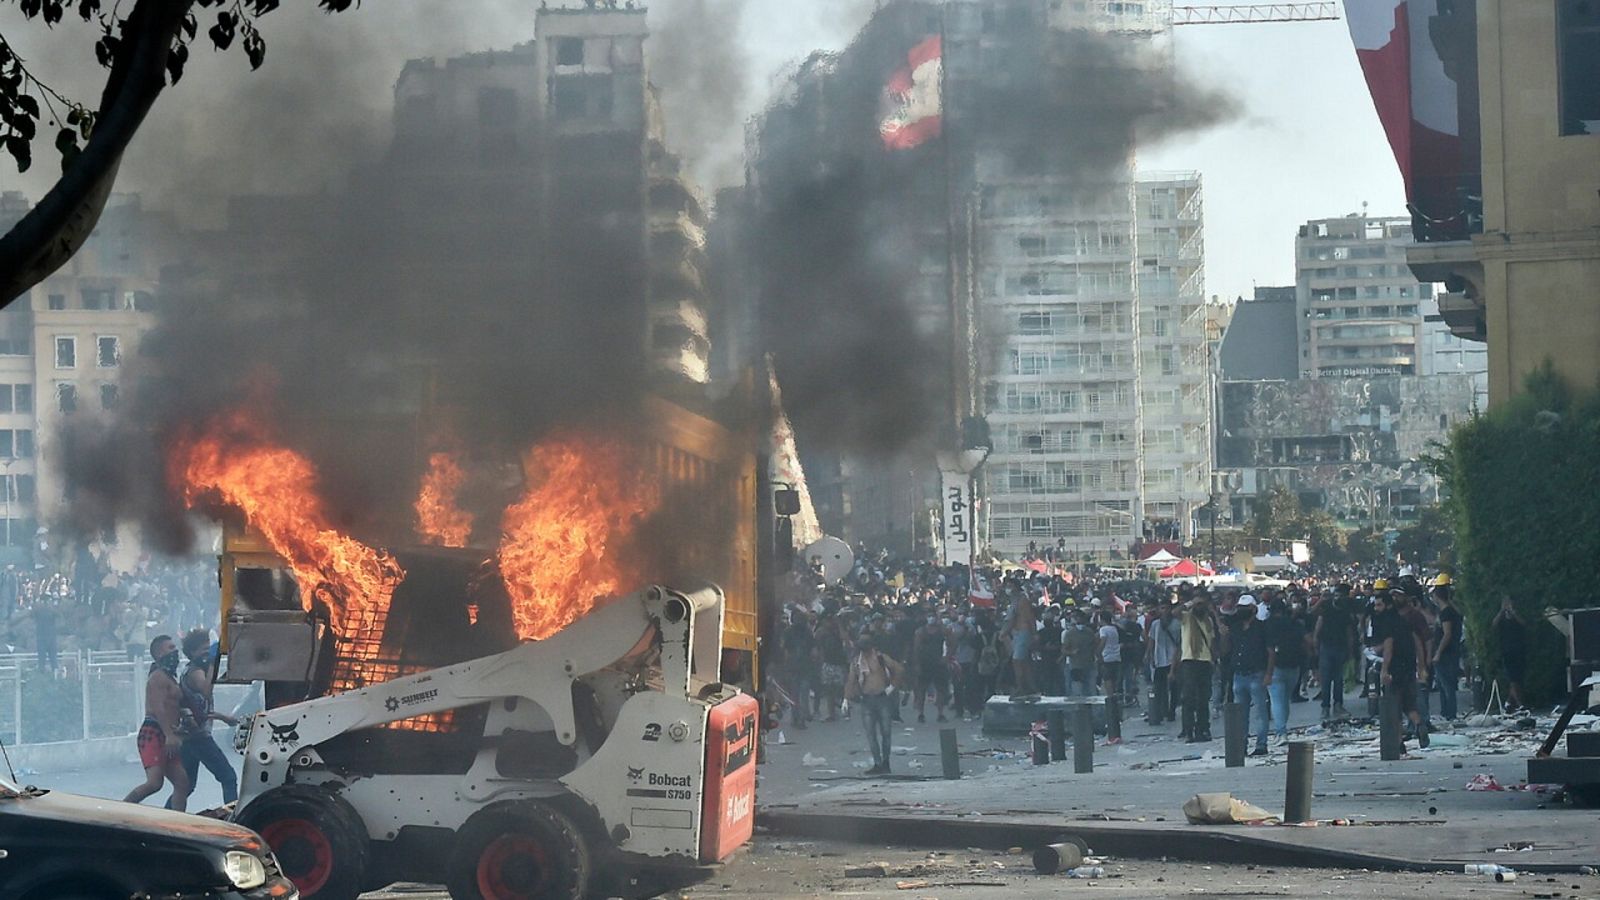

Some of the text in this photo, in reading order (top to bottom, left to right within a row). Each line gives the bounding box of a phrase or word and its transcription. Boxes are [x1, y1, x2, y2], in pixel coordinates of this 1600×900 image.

[947, 486, 968, 542] للوطن
[401, 689, 438, 704] SUNBELT
[648, 773, 691, 787] Bobcat
[668, 789, 691, 800] S750
